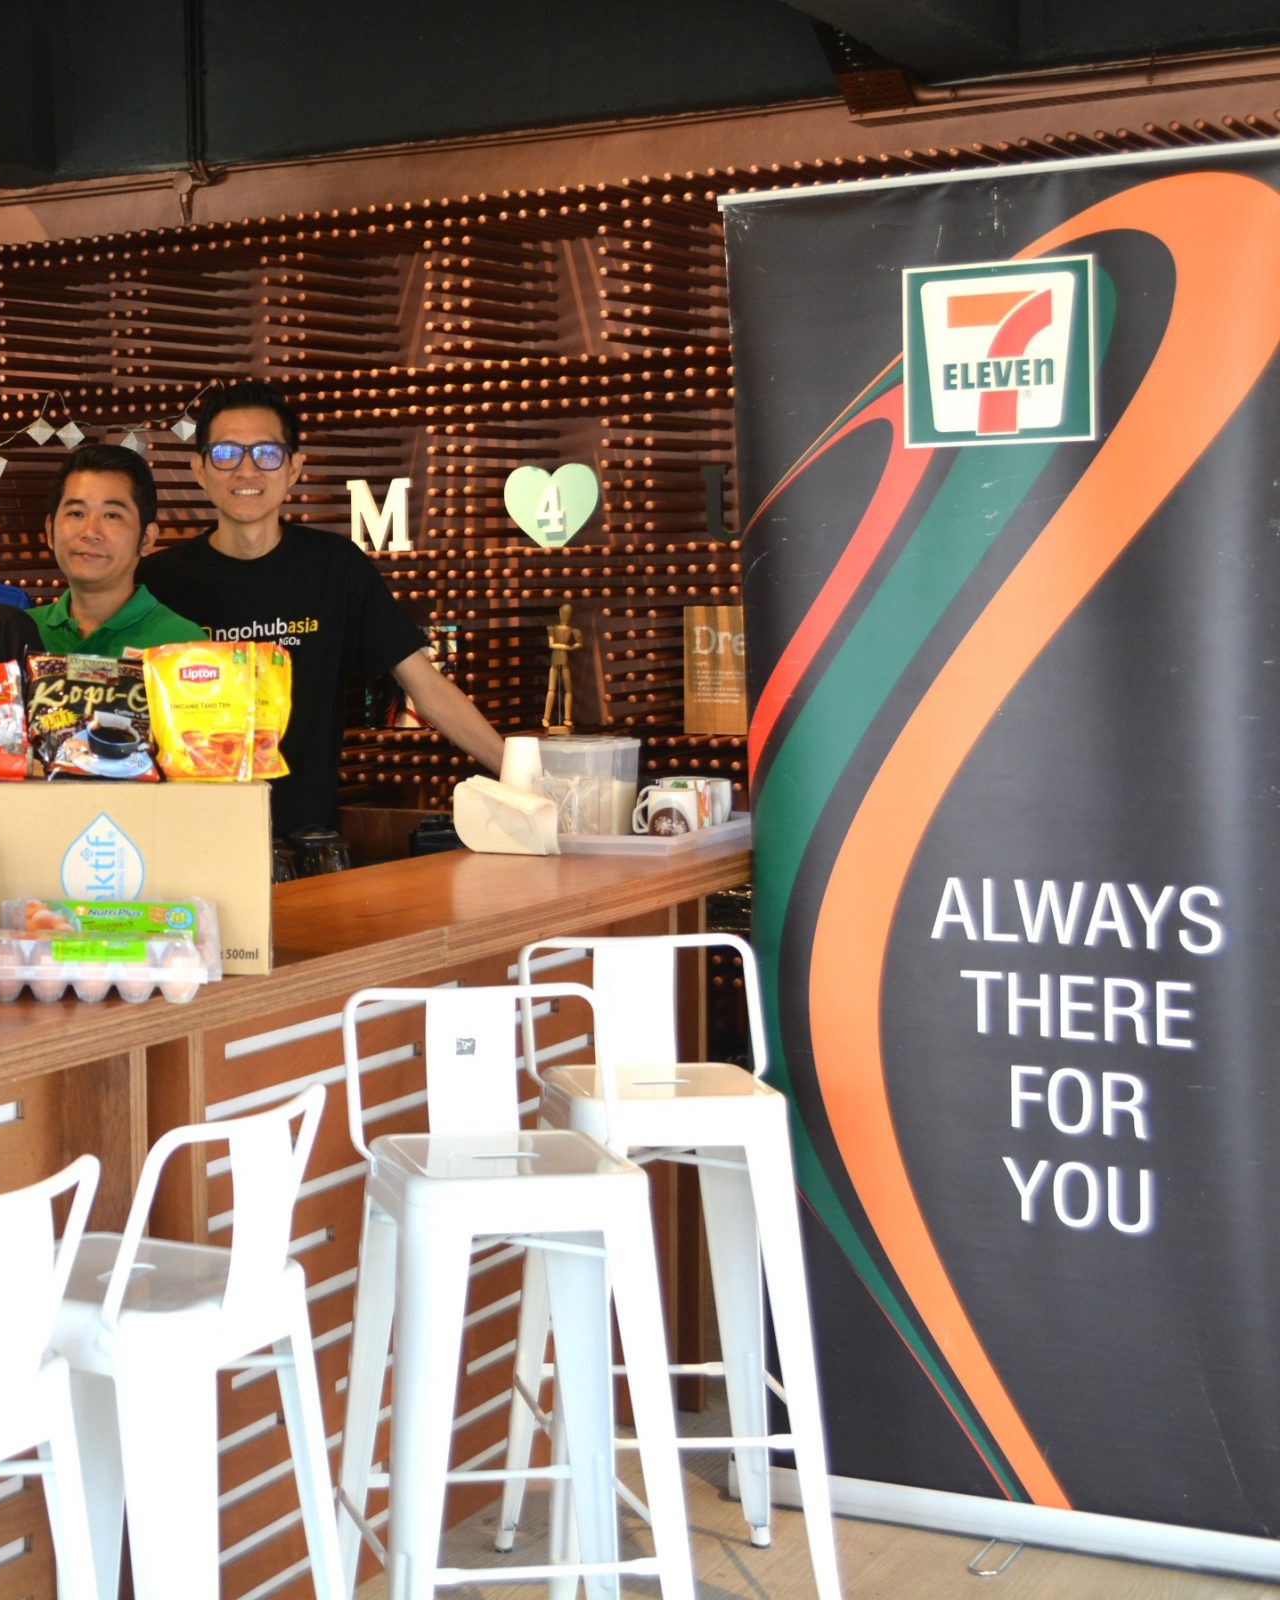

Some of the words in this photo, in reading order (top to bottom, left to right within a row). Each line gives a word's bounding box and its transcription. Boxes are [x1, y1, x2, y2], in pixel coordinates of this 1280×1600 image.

[947, 288, 1052, 433] 7
[347, 477, 413, 551] M
[535, 484, 565, 533] 4
[216, 617, 318, 642] ngohubasia
[182, 669, 217, 679] Lipton
[930, 877, 1223, 955] ALWAYS
[226, 949, 258, 960] 500ml
[960, 970, 1193, 1049] THERE
[1011, 1065, 1147, 1140] FOR
[1002, 1156, 1153, 1233] YOU
